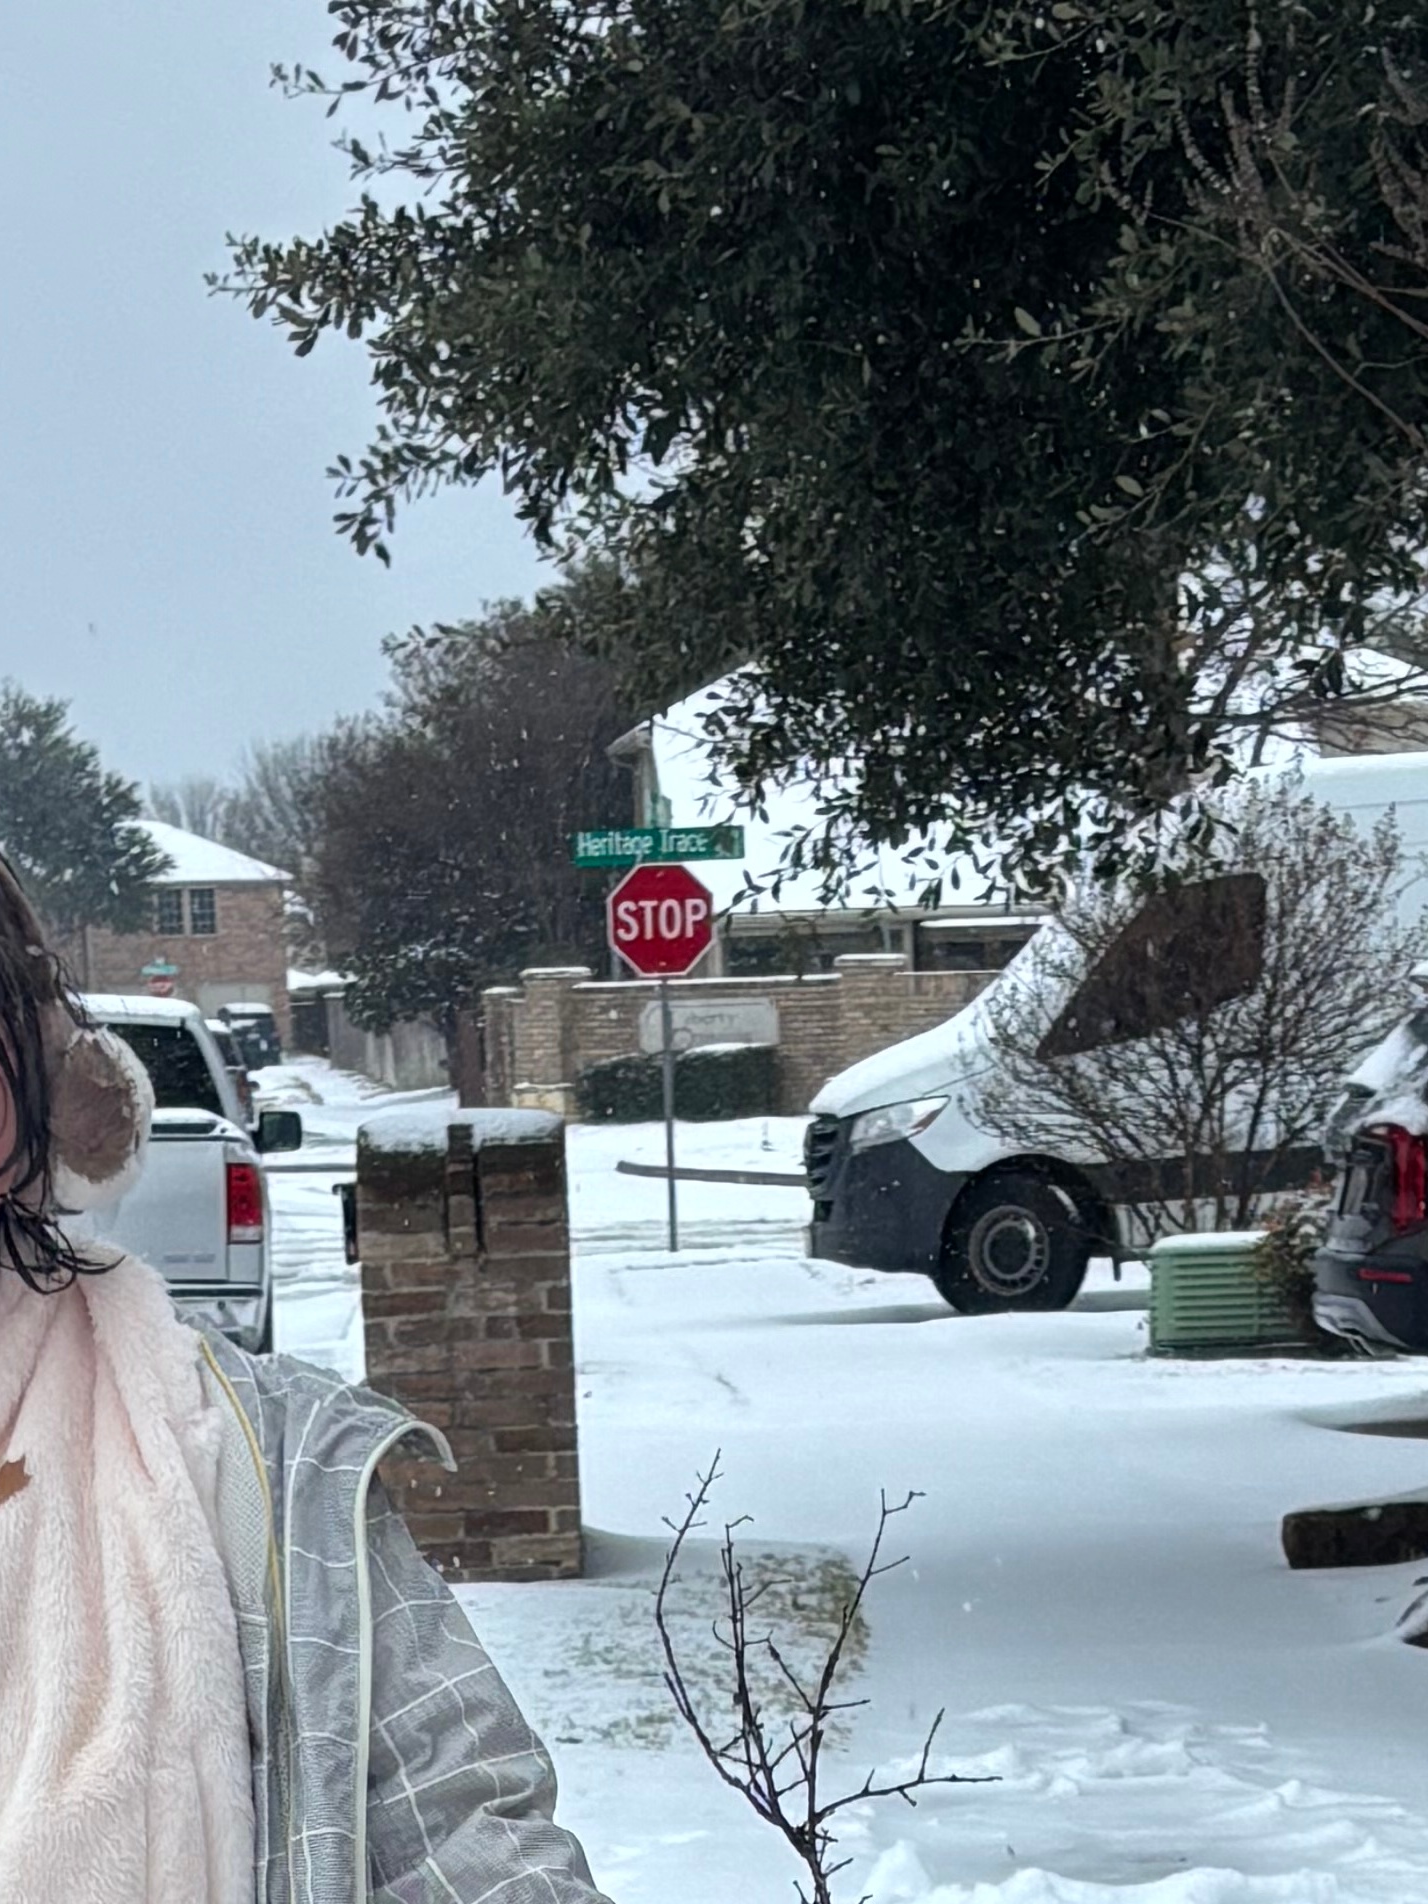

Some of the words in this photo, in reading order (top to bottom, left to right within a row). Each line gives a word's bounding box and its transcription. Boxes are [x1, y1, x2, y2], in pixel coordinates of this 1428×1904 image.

[577, 831, 653, 858] Heritage
[659, 829, 708, 854] Trace
[617, 899, 708, 941] STOP
